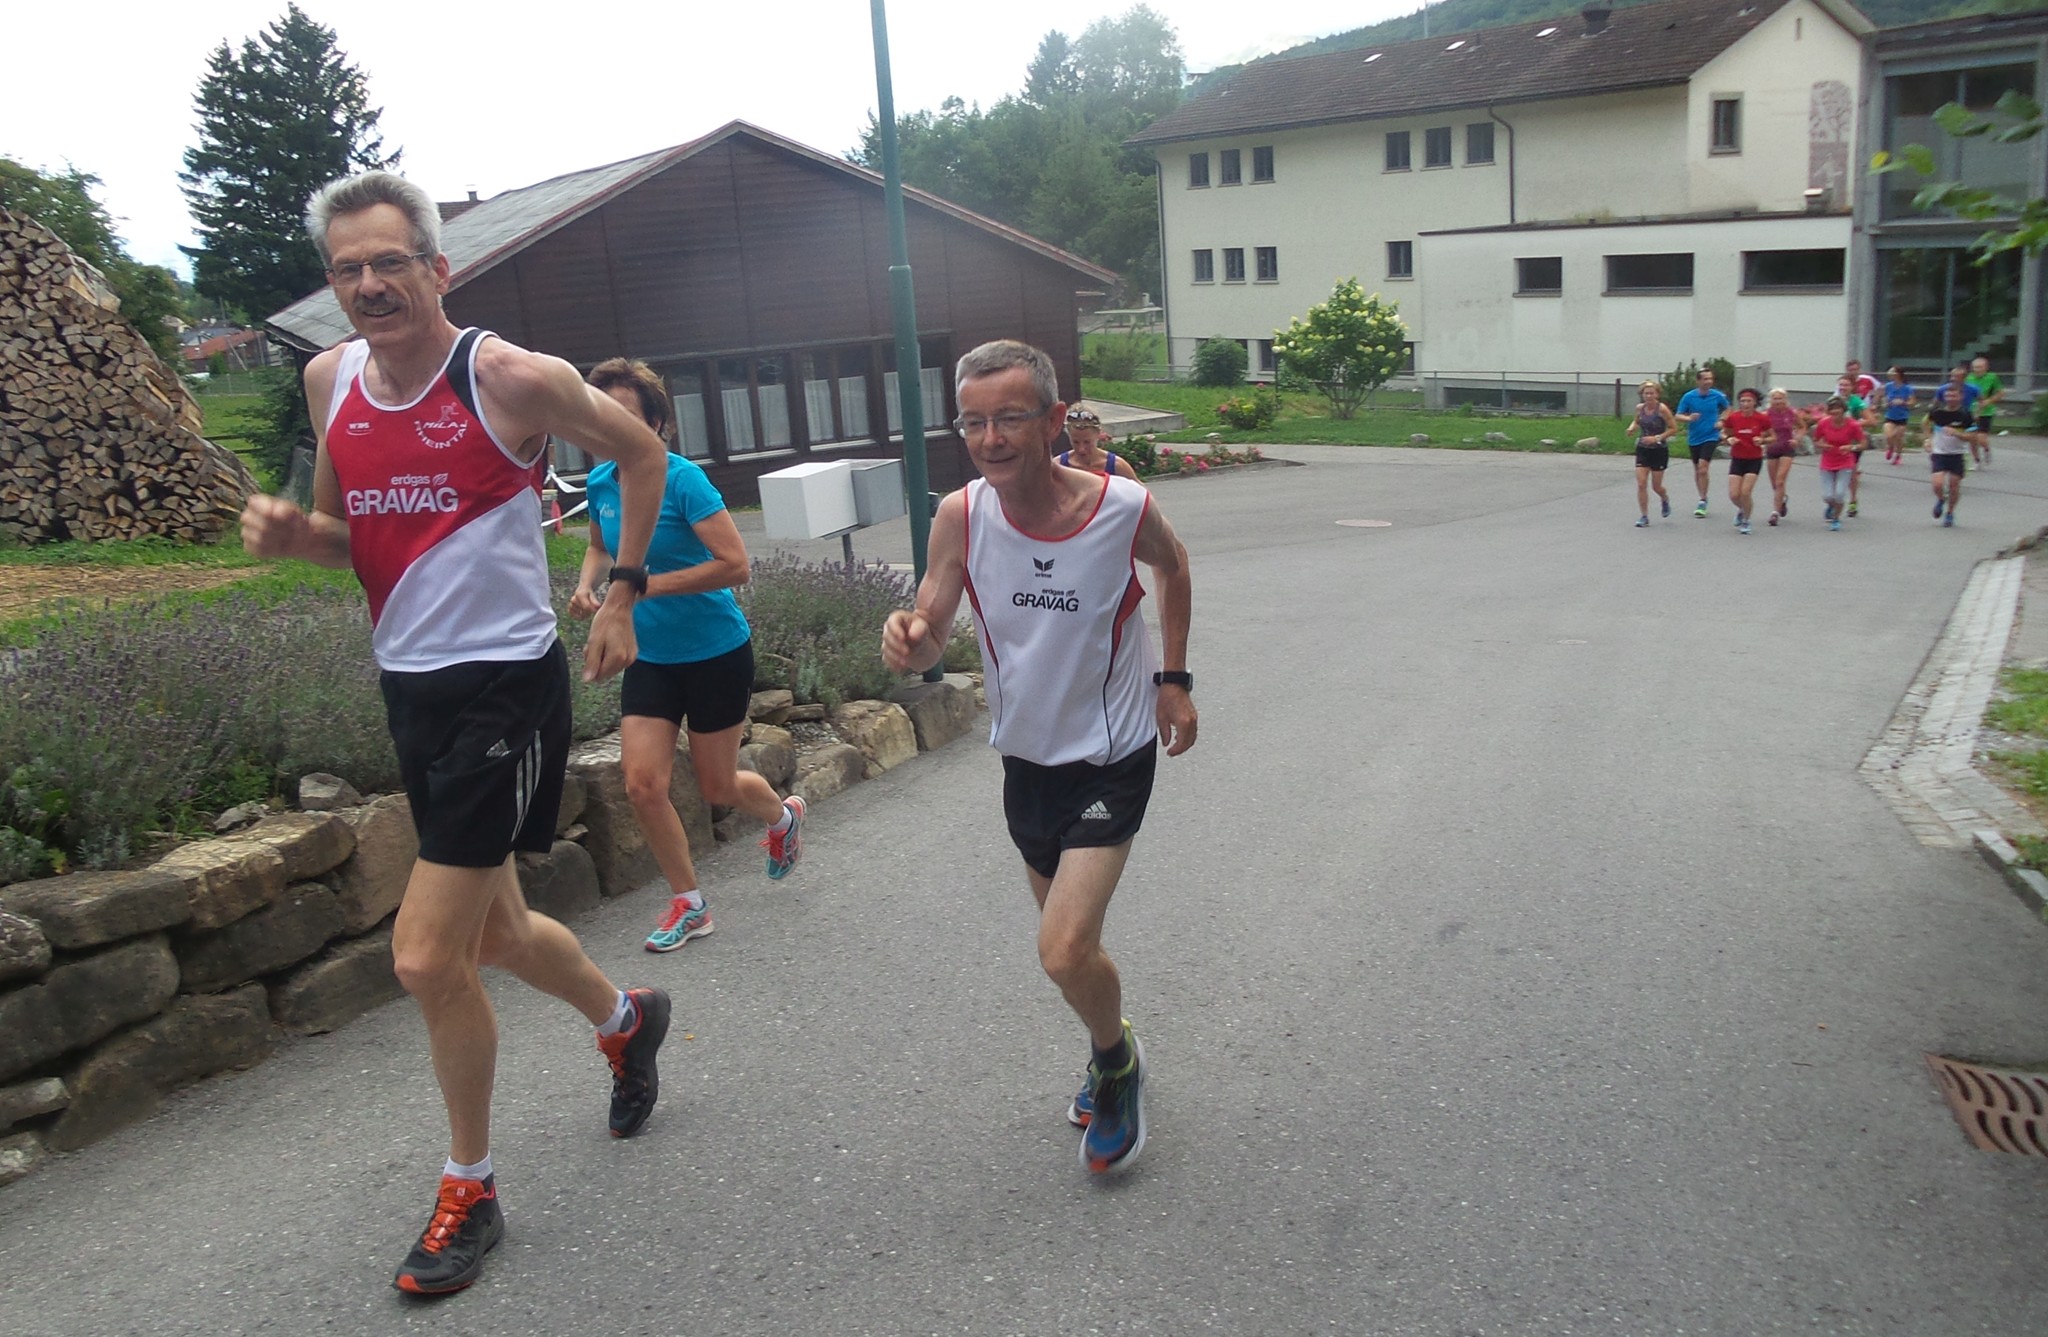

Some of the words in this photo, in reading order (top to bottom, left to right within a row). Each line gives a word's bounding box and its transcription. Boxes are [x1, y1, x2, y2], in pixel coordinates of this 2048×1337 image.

[391, 474, 430, 486] erdgas
[347, 488, 458, 516] GRAVAG
[1042, 588, 1064, 596] erdgas
[1012, 592, 1079, 612] GRAVAG
[1081, 812, 1112, 820] adidas
